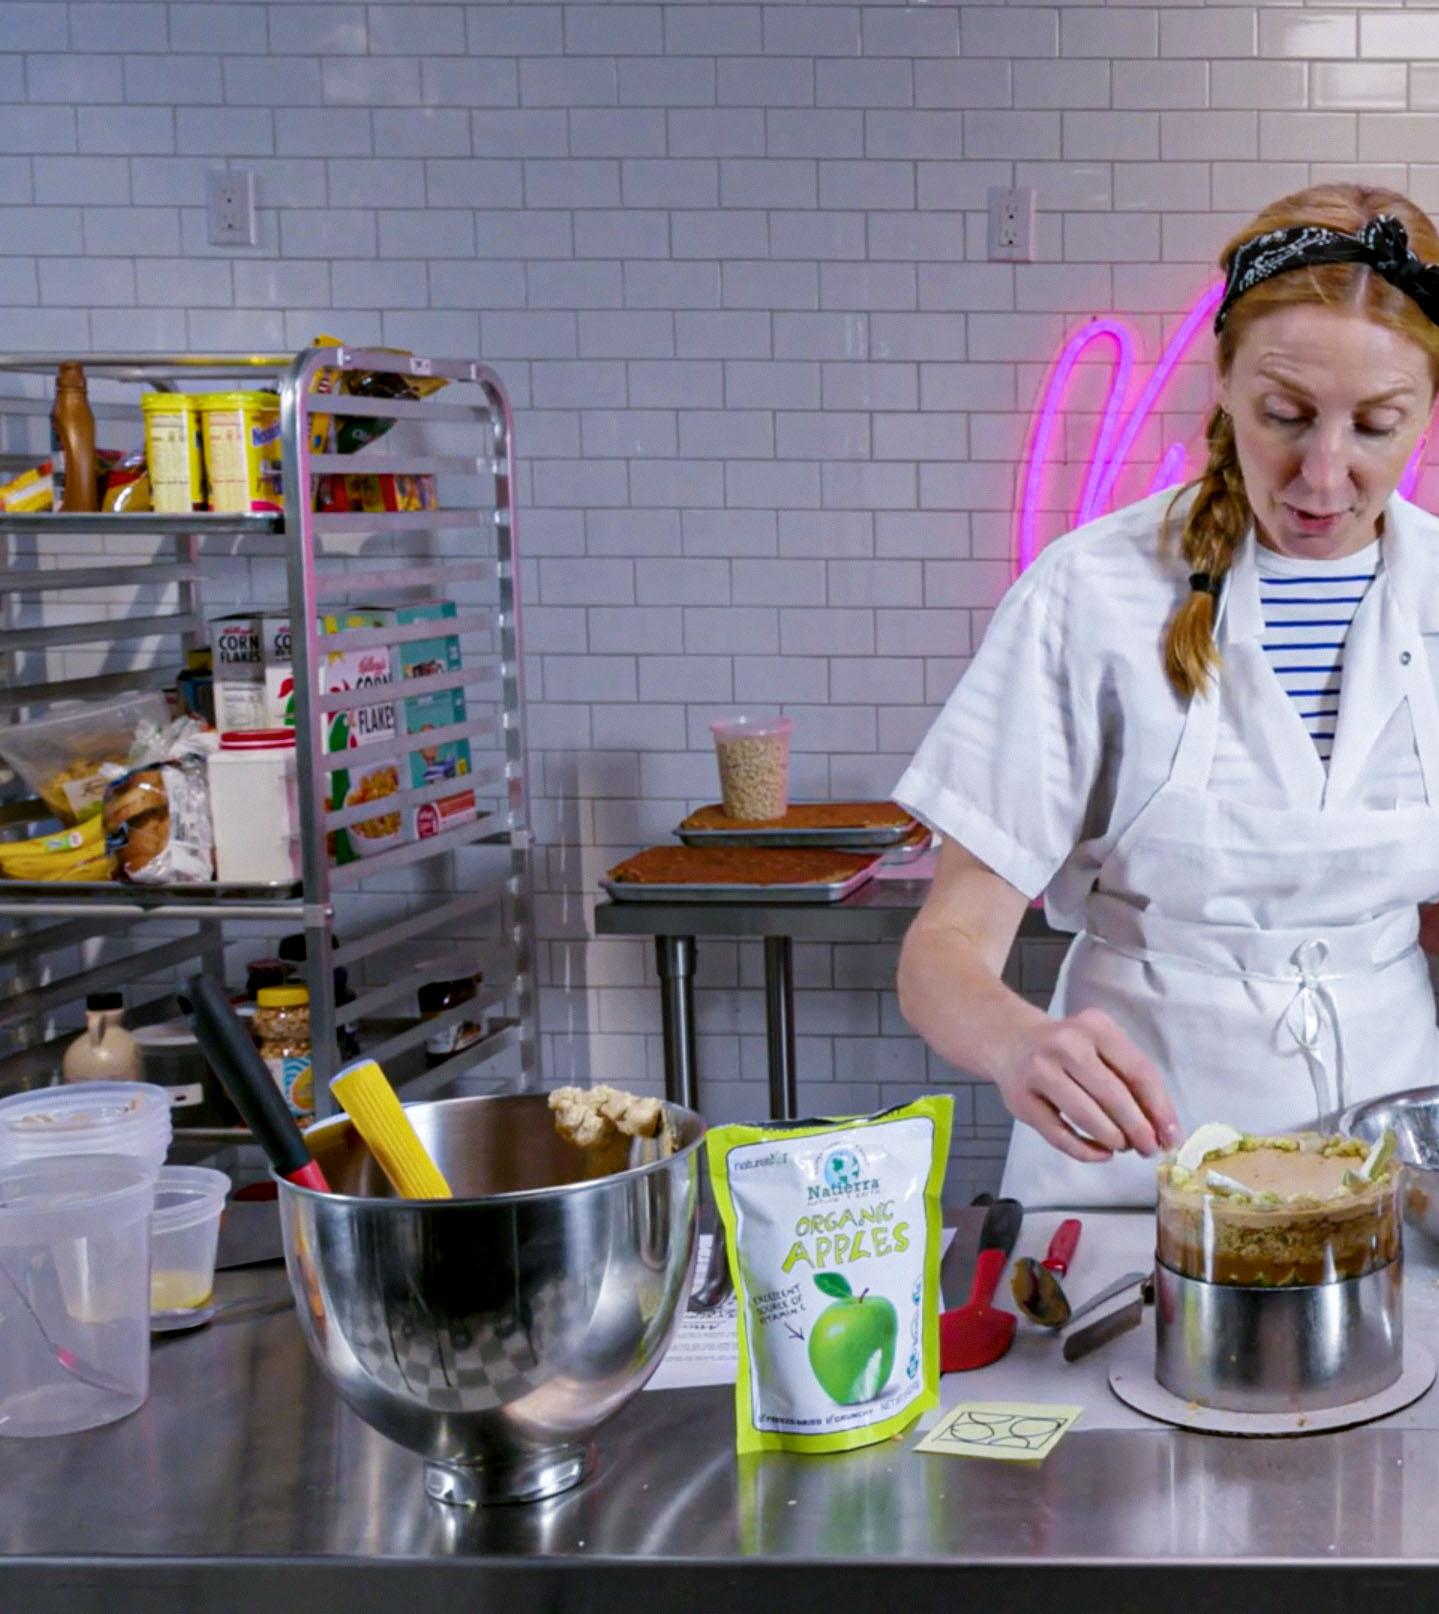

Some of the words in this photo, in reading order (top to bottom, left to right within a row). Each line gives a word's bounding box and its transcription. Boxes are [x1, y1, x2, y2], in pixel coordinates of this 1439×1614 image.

[218, 635, 260, 650] CORN
[274, 634, 292, 649] CO
[219, 651, 262, 663] FLAKES
[807, 1178, 880, 1200] Natierra
[795, 1200, 896, 1237] ORGANIC
[781, 1222, 910, 1273] APPLES
